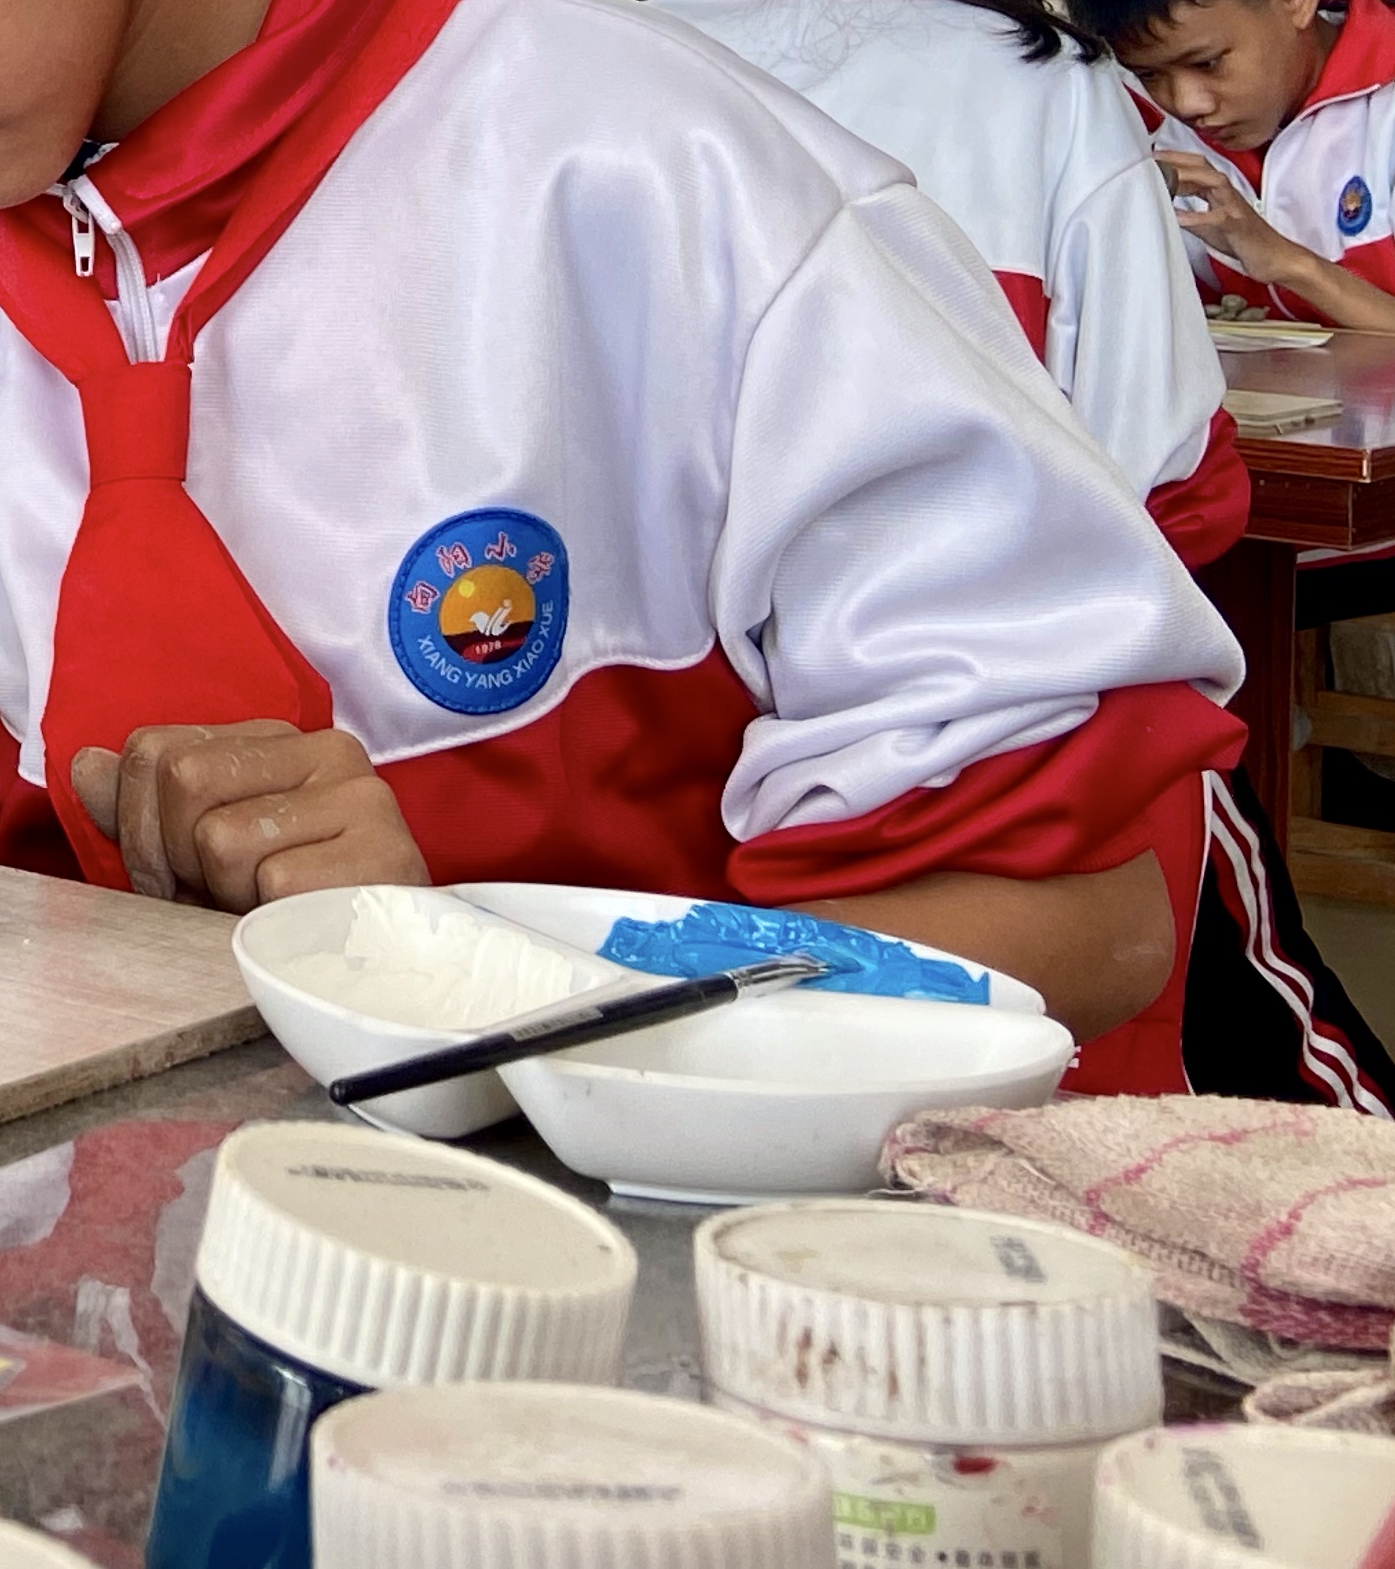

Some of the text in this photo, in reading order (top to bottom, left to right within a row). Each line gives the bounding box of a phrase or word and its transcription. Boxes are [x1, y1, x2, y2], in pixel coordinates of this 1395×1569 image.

[405, 530, 555, 614] 向阳小学
[417, 600, 554, 689] XIANG YANG XIAO XUE
